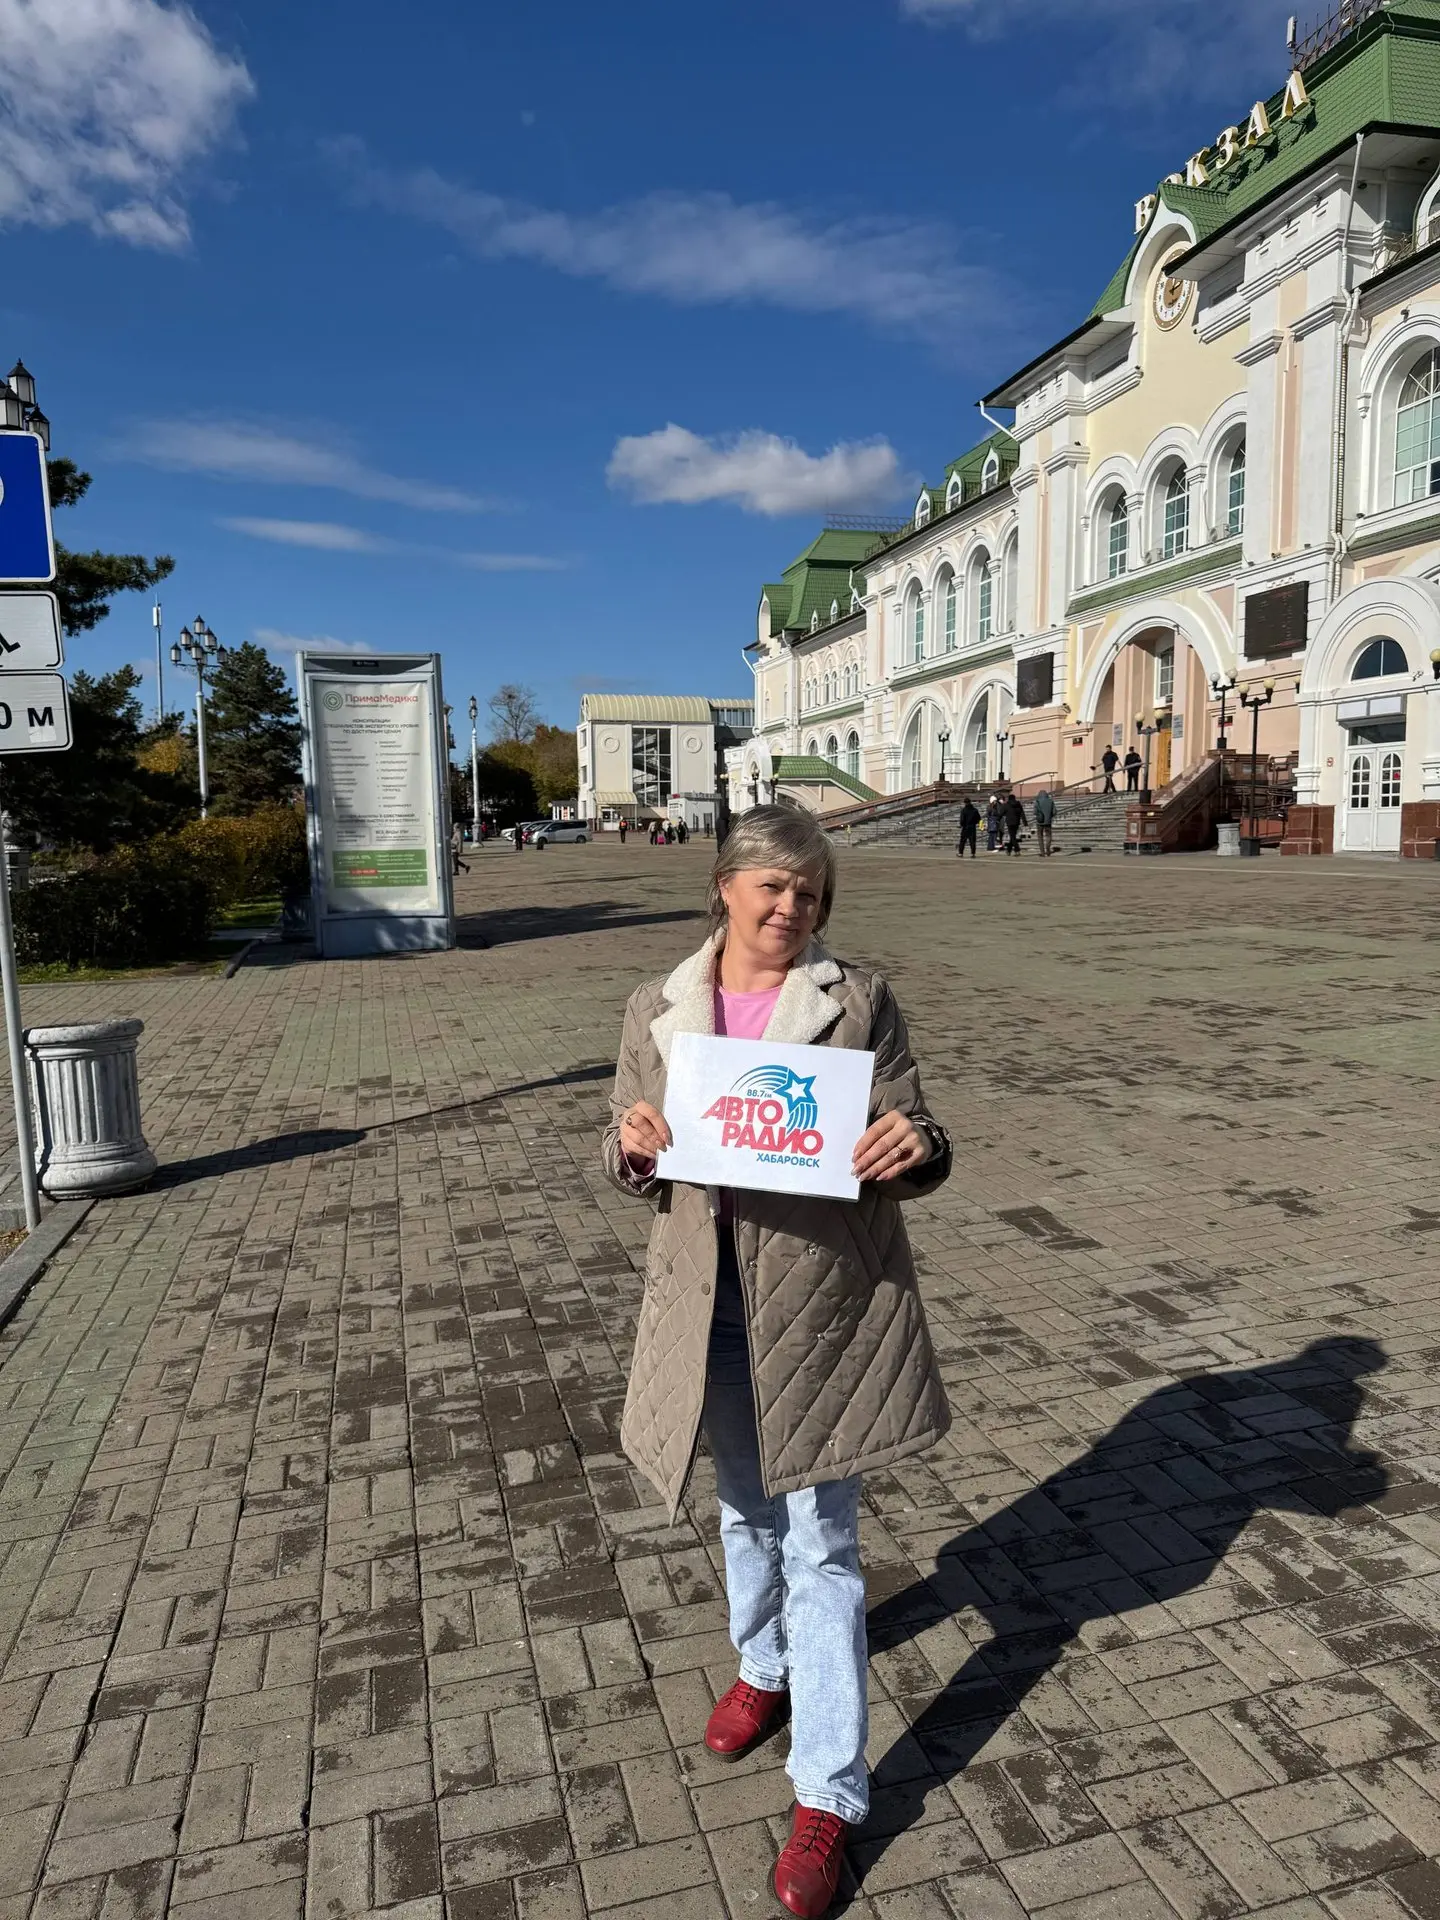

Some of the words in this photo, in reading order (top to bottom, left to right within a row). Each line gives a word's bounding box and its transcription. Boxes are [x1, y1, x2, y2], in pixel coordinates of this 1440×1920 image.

[345, 694, 418, 705] ПримаМедика
[701, 1095, 784, 1126] АВТО
[720, 1122, 825, 1157] РАДИО
[756, 1152, 821, 1168] ХАБАРОВСК
